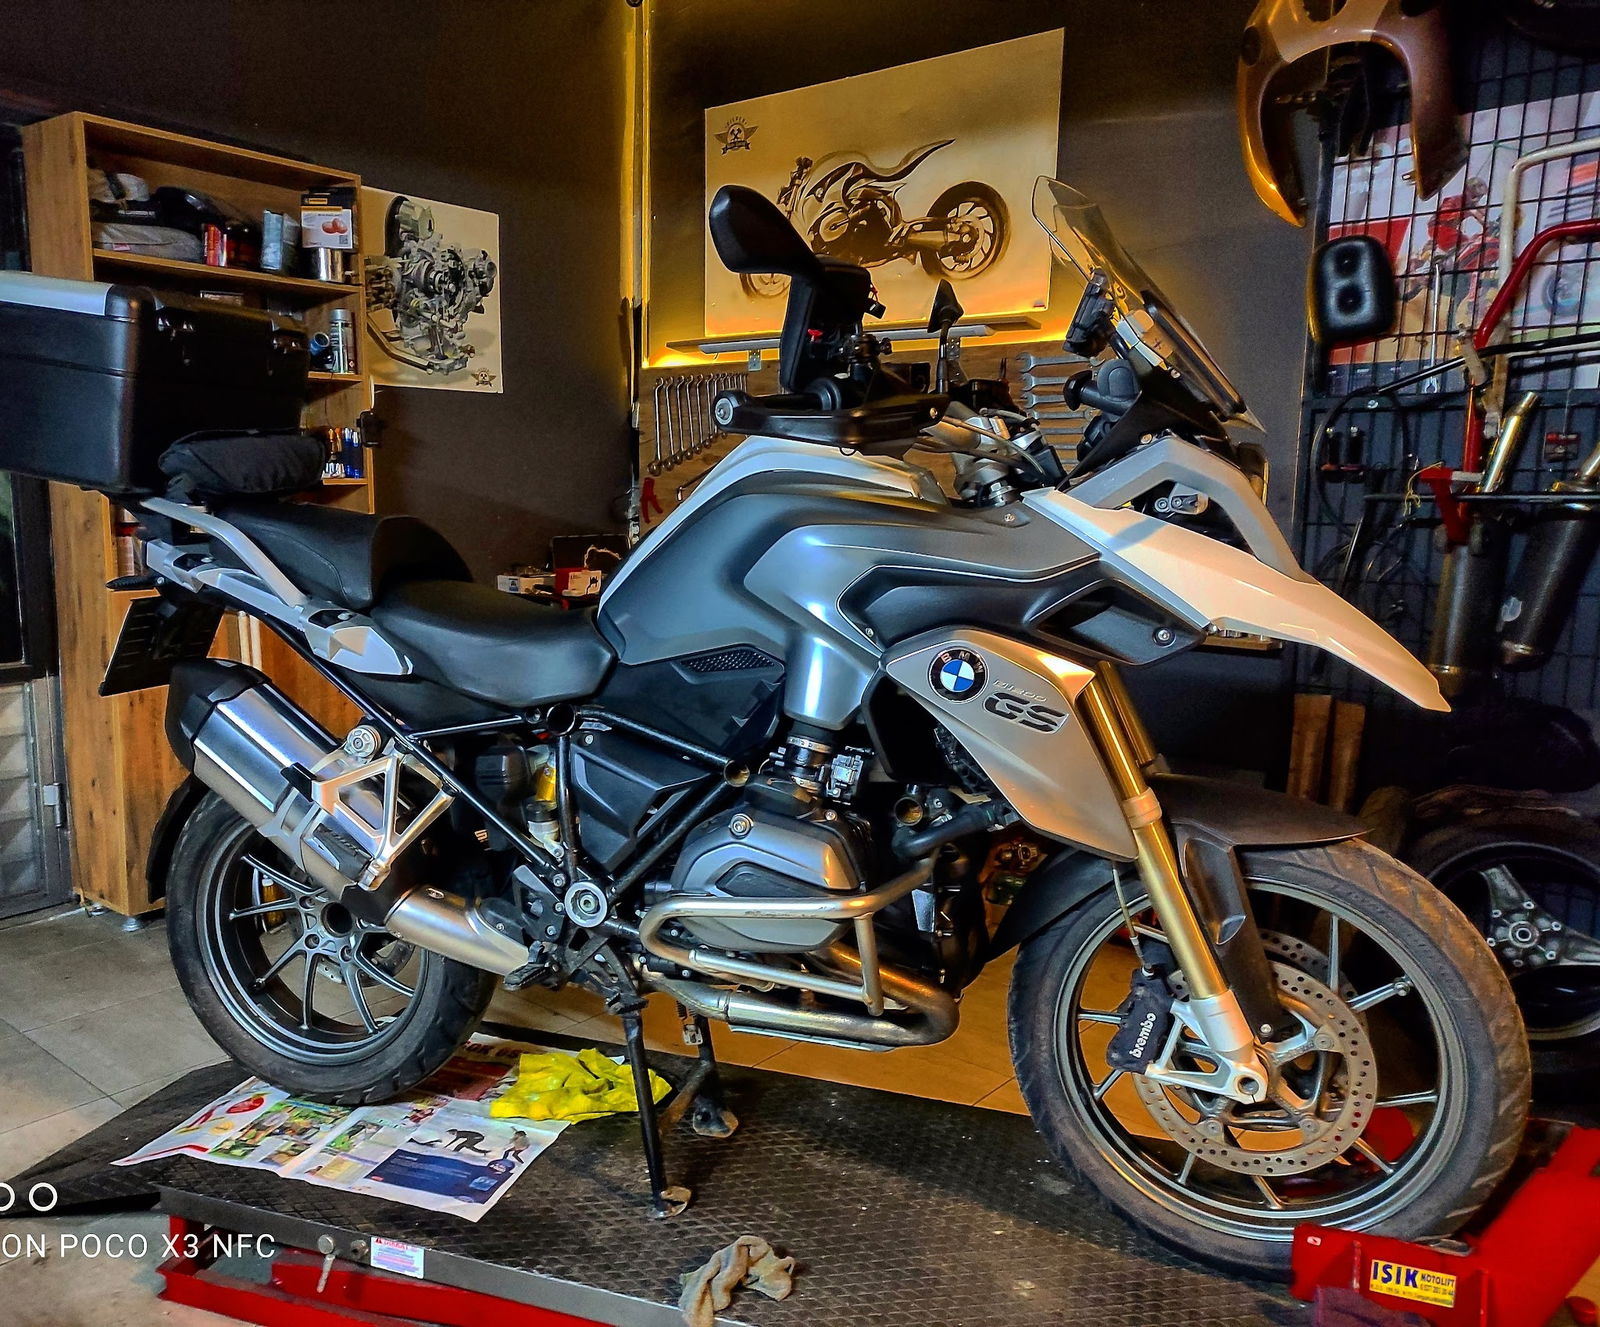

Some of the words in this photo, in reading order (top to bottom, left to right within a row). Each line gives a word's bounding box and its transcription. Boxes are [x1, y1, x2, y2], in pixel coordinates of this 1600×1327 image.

[940, 650, 985, 674] BMW
[982, 692, 1069, 735] GS
[1128, 1012, 1157, 1058] brembo
